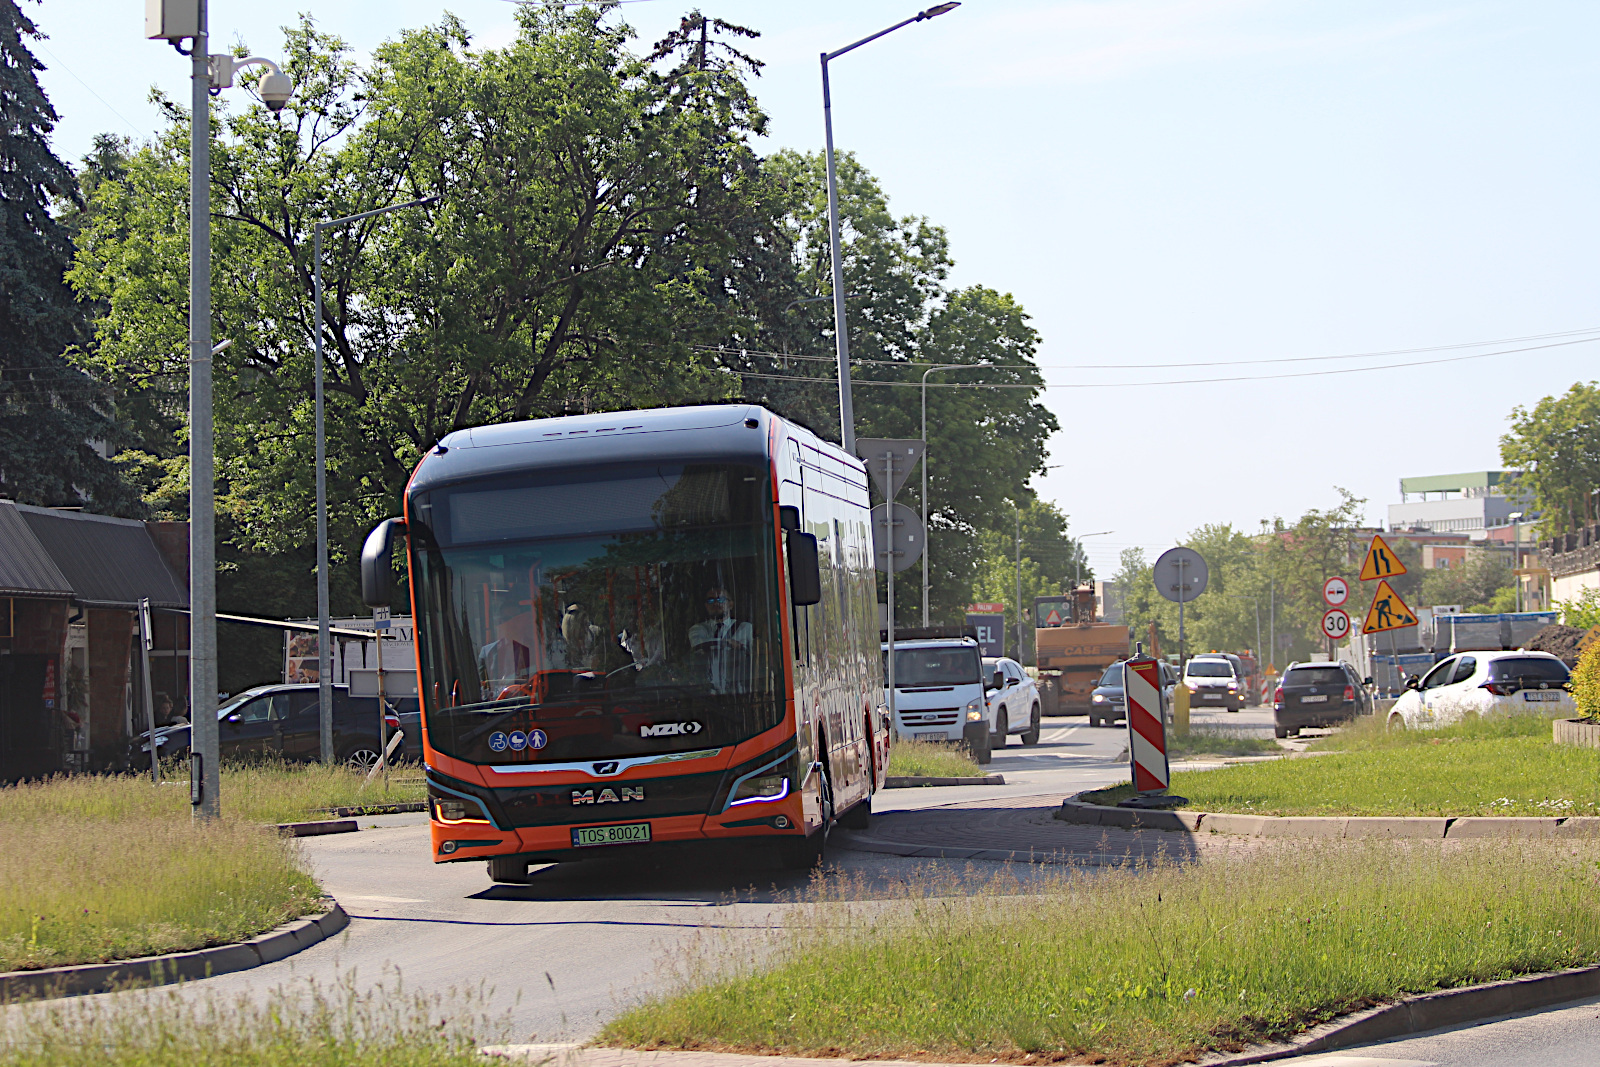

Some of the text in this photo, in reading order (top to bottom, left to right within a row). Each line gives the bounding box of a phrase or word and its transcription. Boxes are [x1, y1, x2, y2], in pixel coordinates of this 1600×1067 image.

[1326, 616, 1346, 631] 30
[976, 626, 996, 643] EL
[1064, 646, 1101, 656] CASE
[572, 786, 644, 805] MAN
[580, 829, 605, 843] TOS
[608, 825, 647, 841] 80021
